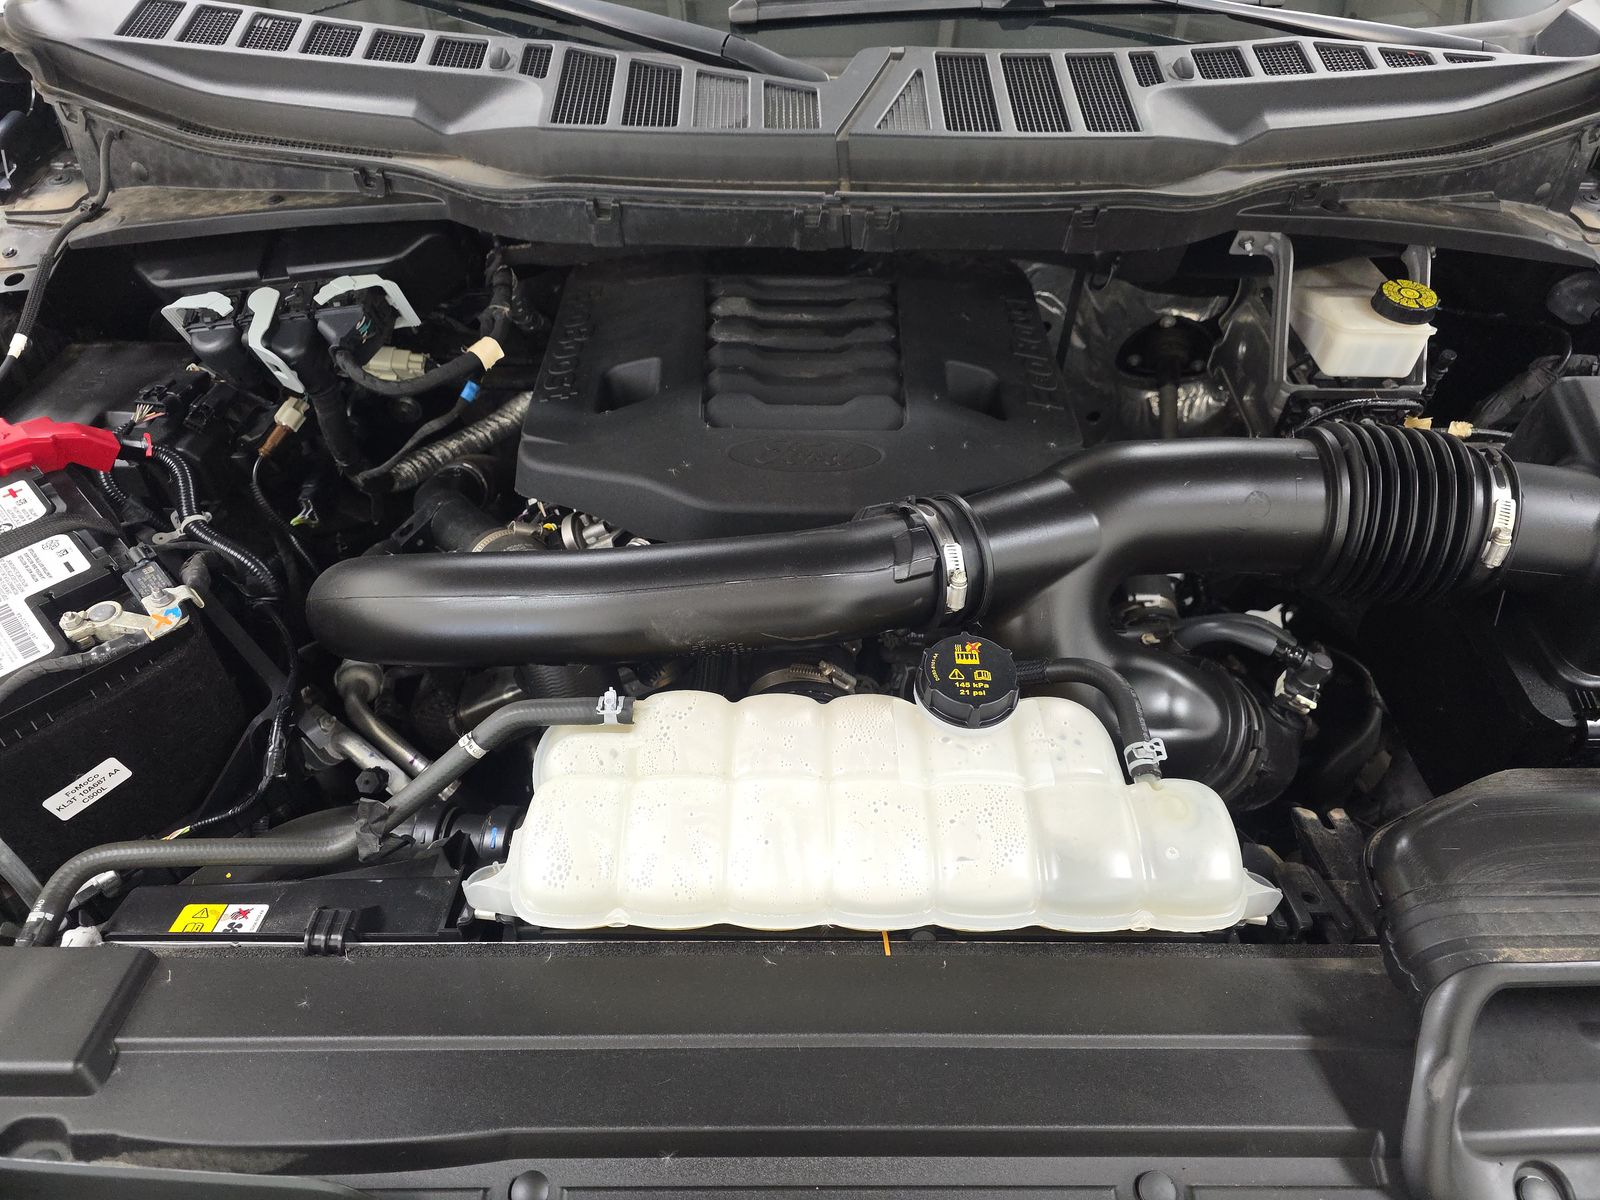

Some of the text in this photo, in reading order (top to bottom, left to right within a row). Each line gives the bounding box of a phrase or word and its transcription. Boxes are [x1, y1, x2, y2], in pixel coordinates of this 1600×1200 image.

[56, 768, 121, 812] KL3T 10A687 AA
[65, 773, 100, 797] FoMoCo
[82, 786, 108, 804] C500L
